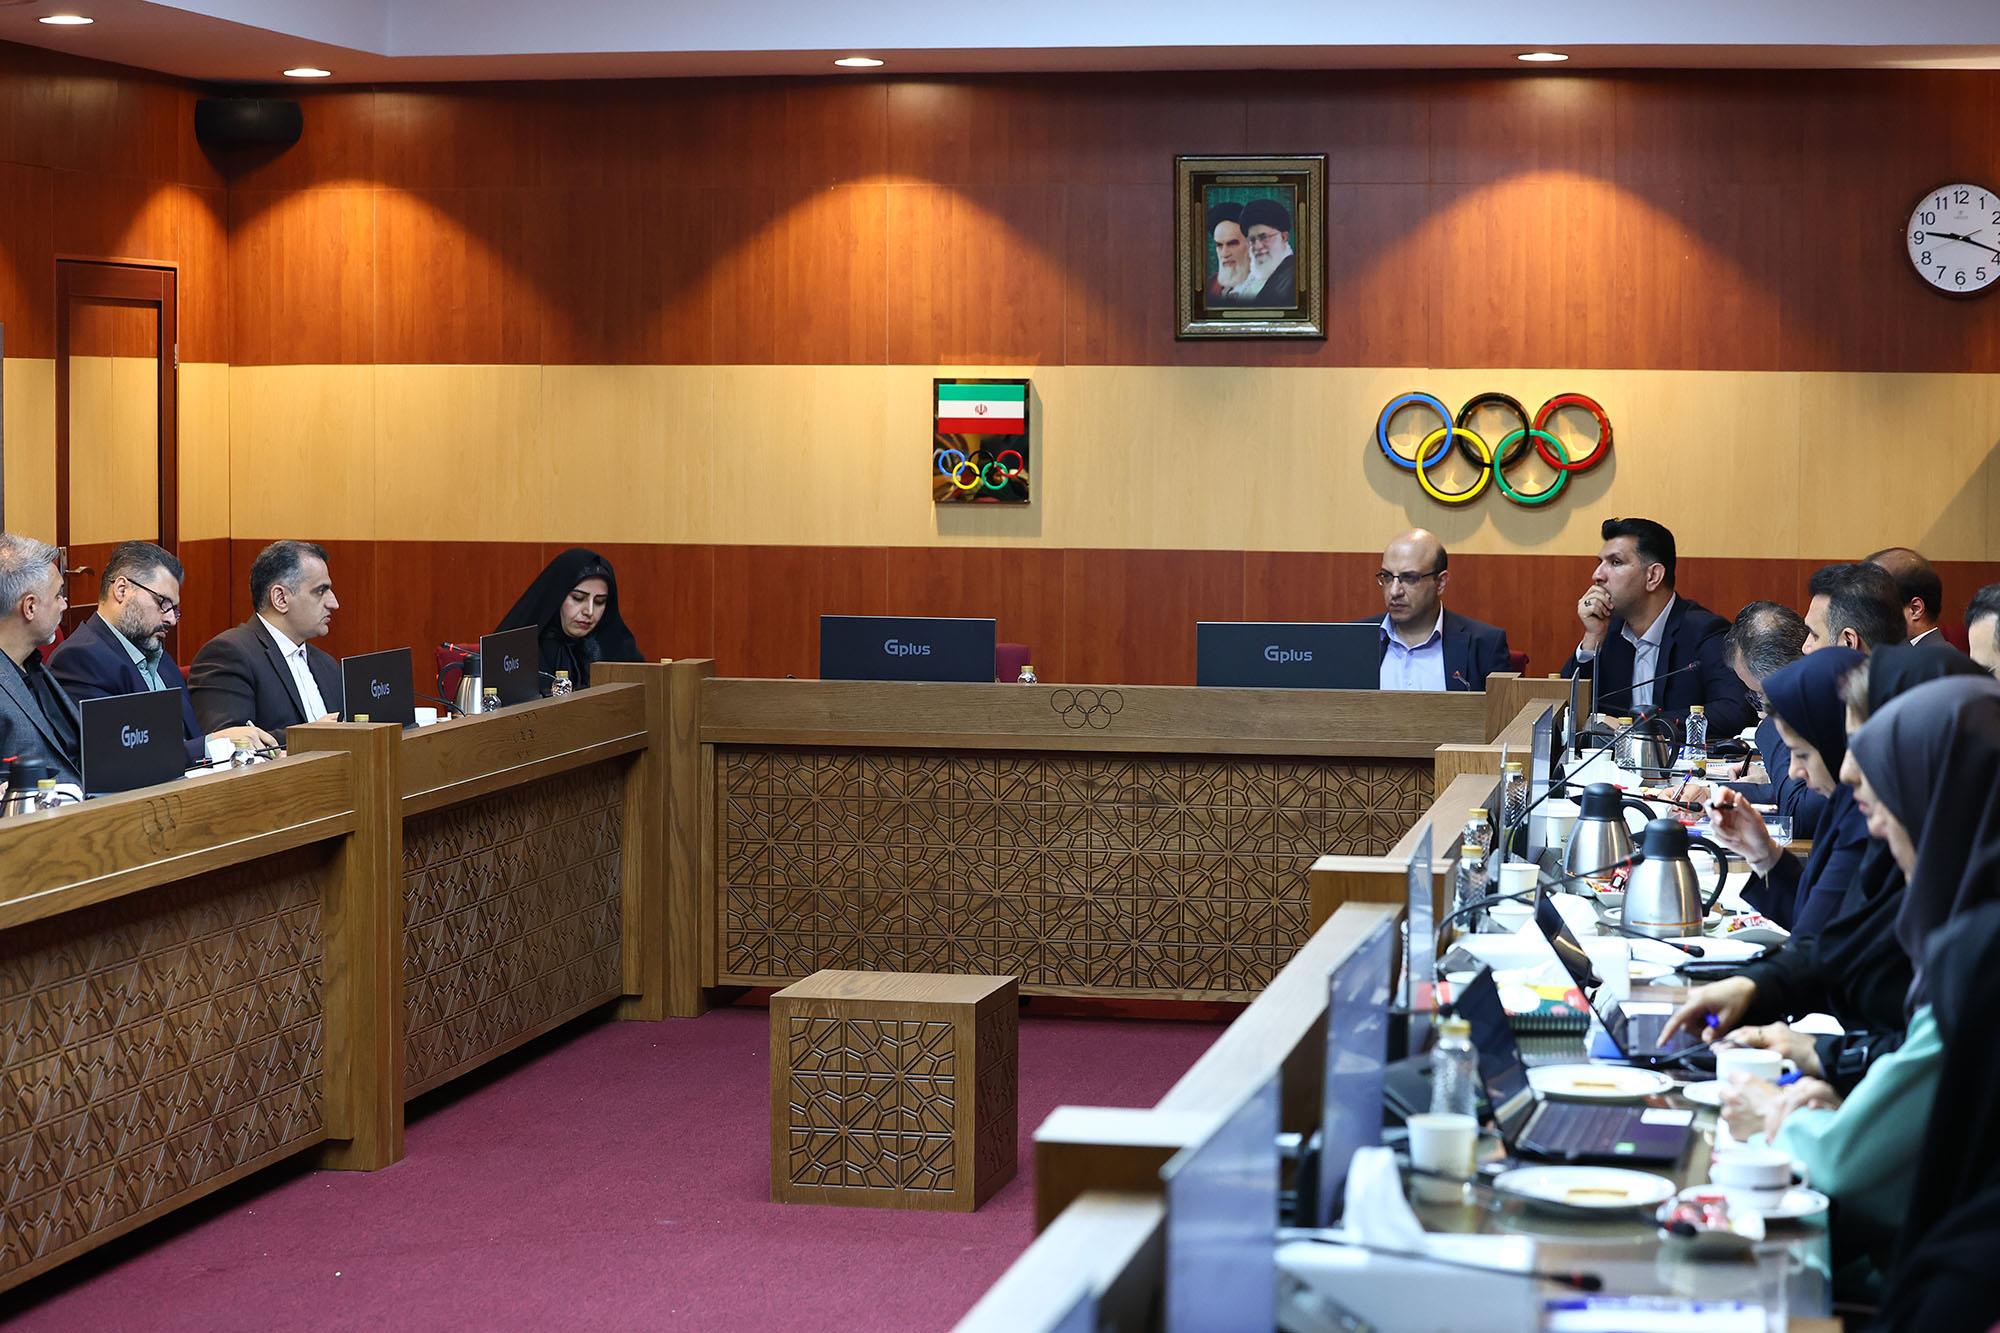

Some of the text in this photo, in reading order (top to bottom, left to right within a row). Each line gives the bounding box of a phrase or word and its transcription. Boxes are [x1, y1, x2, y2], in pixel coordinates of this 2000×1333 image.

[1935, 196, 1948, 210] 11
[1953, 190, 1970, 205] 12
[1979, 196, 1985, 210] 1
[1919, 211, 1936, 225] 10
[1913, 230, 1925, 245] 9
[1921, 251, 1932, 265] 8
[1936, 265, 1947, 279] 7
[1954, 271, 1966, 285] 6
[1975, 266, 1986, 280] 5
[884, 639, 931, 657] Gplus
[1264, 645, 1313, 664] Gplus
[503, 655, 520, 673] Gplus
[370, 679, 390, 699] Gplus
[121, 725, 149, 749] Gplus
